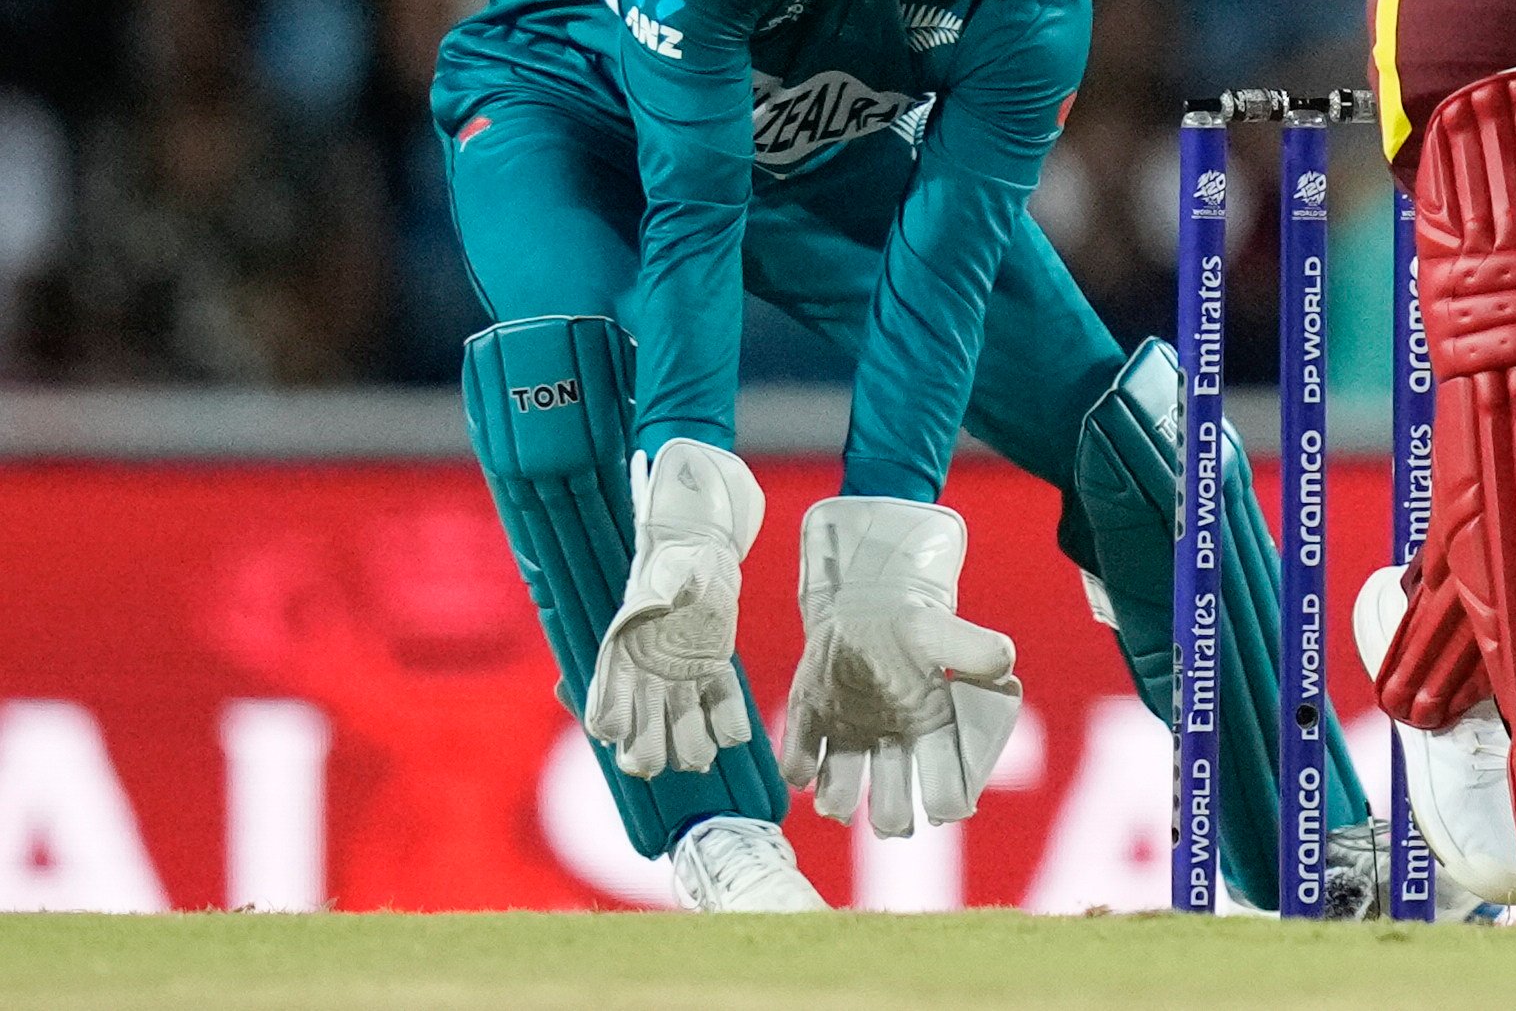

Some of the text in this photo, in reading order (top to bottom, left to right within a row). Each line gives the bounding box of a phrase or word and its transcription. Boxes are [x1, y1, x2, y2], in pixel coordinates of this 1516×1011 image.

[624, 5, 684, 60] ANZ
[1193, 255, 1222, 396] Emirates
[1304, 257, 1321, 403] DP WORLD
[511, 379, 579, 413] TON
[1197, 422, 1217, 568] DP WORLD
[1300, 430, 1322, 567] aramco
[1188, 593, 1215, 733] Emirates
[1302, 594, 1319, 698] WORLD
[1190, 759, 1210, 907] DP WORLD
[1298, 767, 1321, 904] aramco
